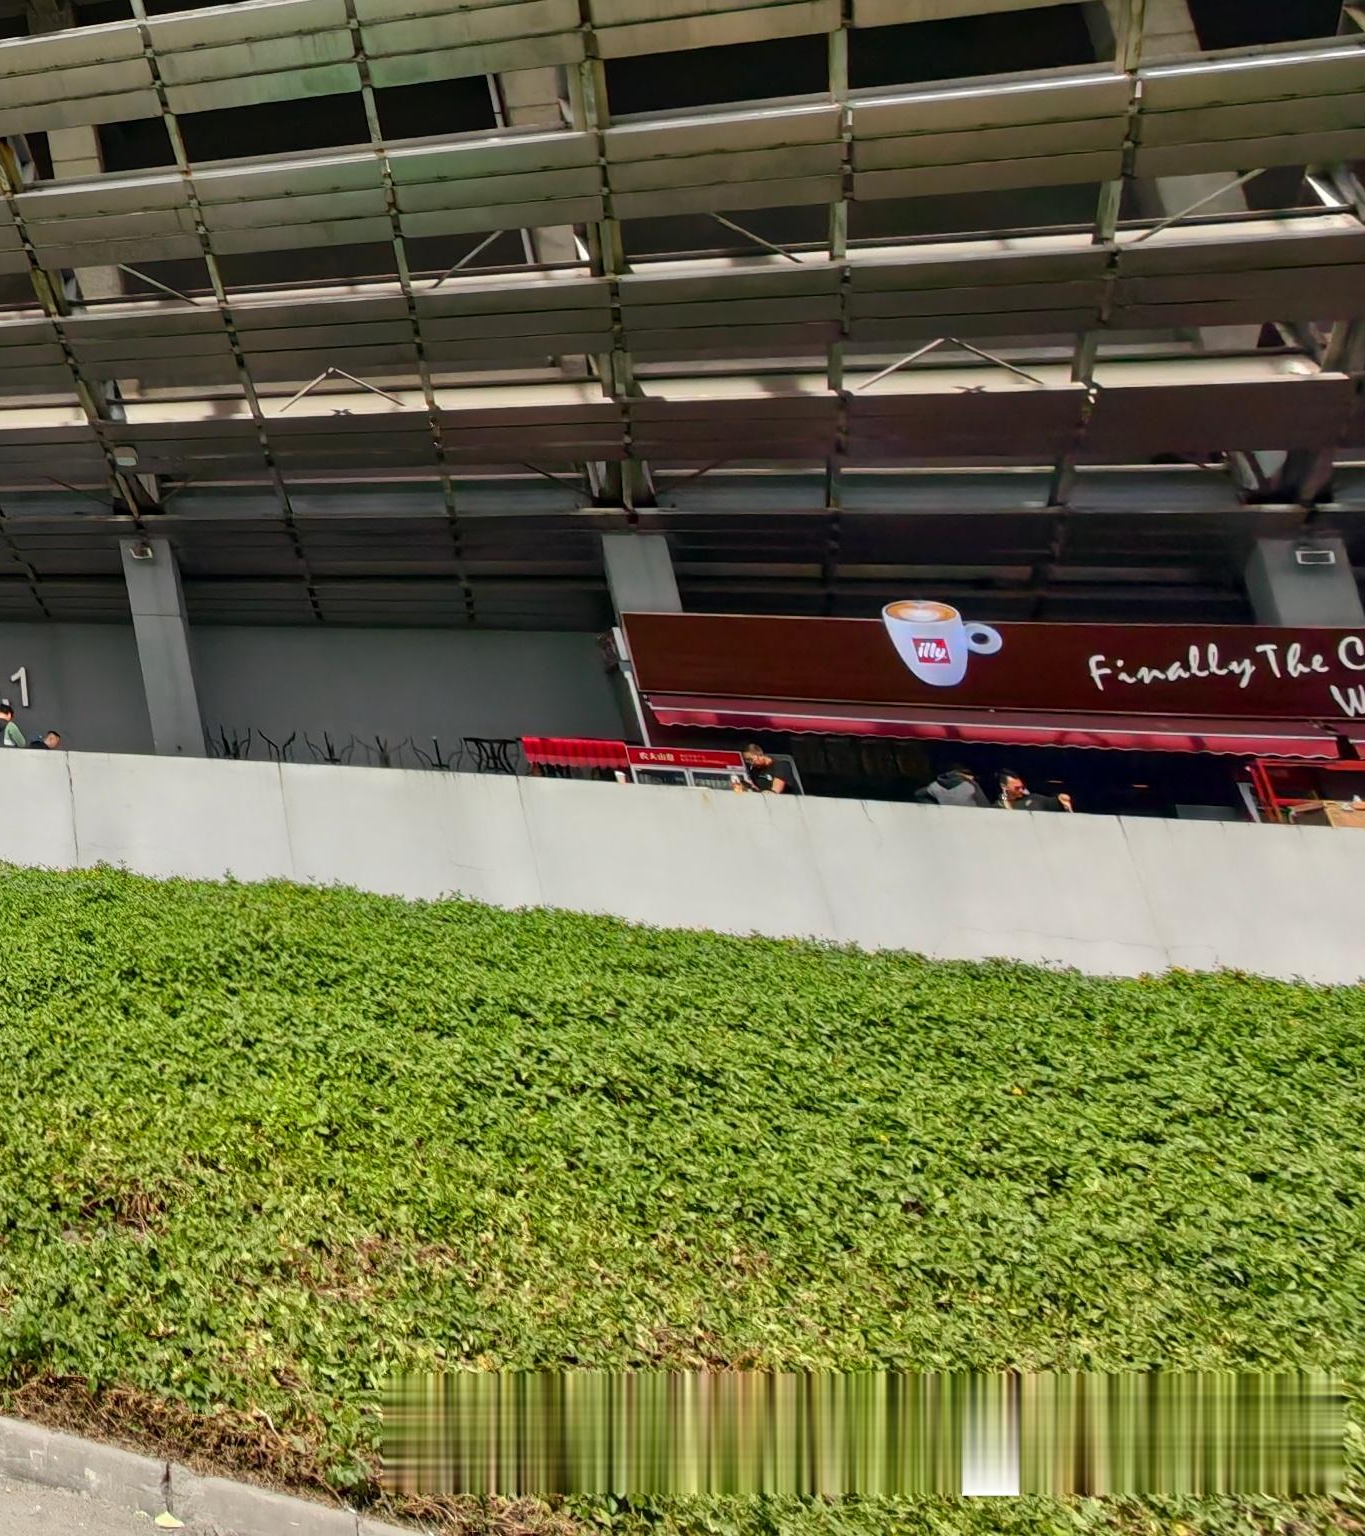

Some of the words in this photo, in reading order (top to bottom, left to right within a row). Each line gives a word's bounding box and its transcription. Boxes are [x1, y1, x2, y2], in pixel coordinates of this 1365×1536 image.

[917, 642, 949, 662] illy
[1088, 643, 1256, 691] Finally
[1255, 642, 1330, 678] The
